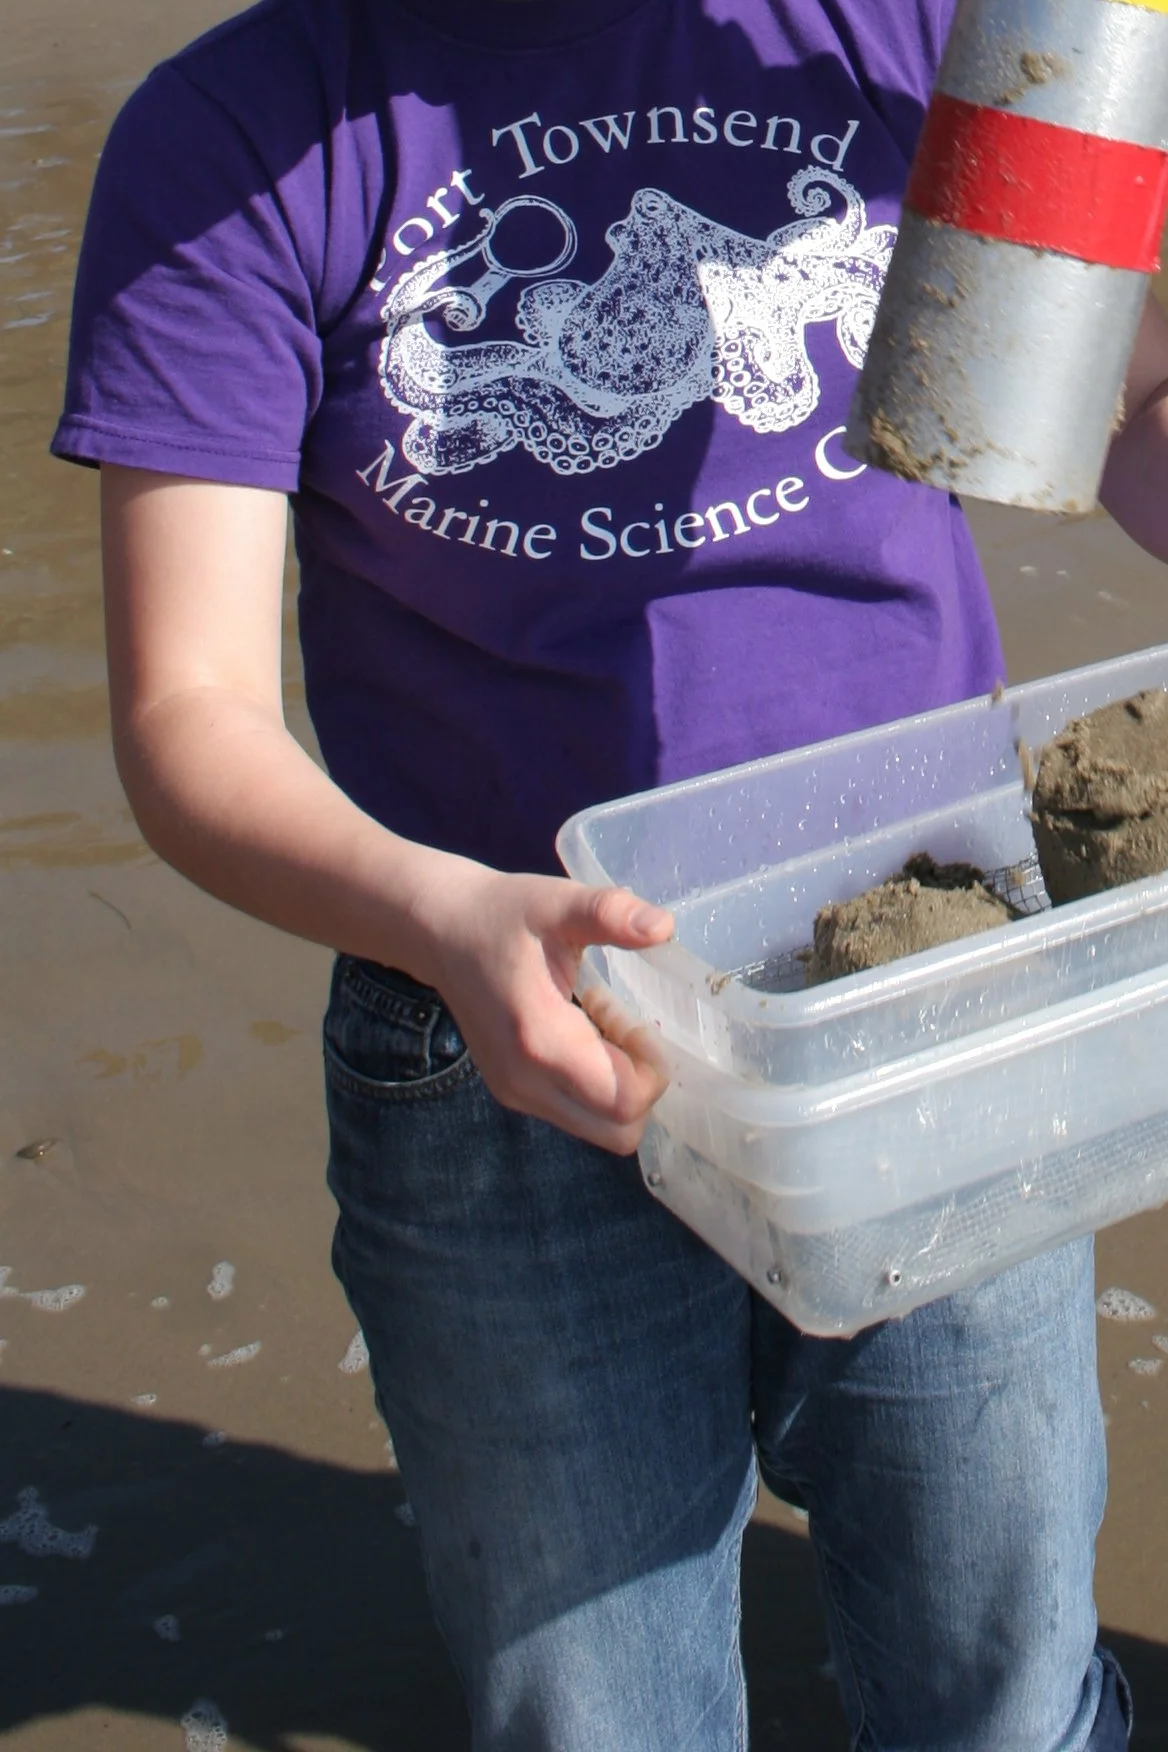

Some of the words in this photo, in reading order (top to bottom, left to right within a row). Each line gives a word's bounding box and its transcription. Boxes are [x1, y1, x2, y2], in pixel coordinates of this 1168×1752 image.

[491, 105, 859, 179] Townsend
[356, 440, 557, 560] Marine
[579, 475, 810, 561] Science
